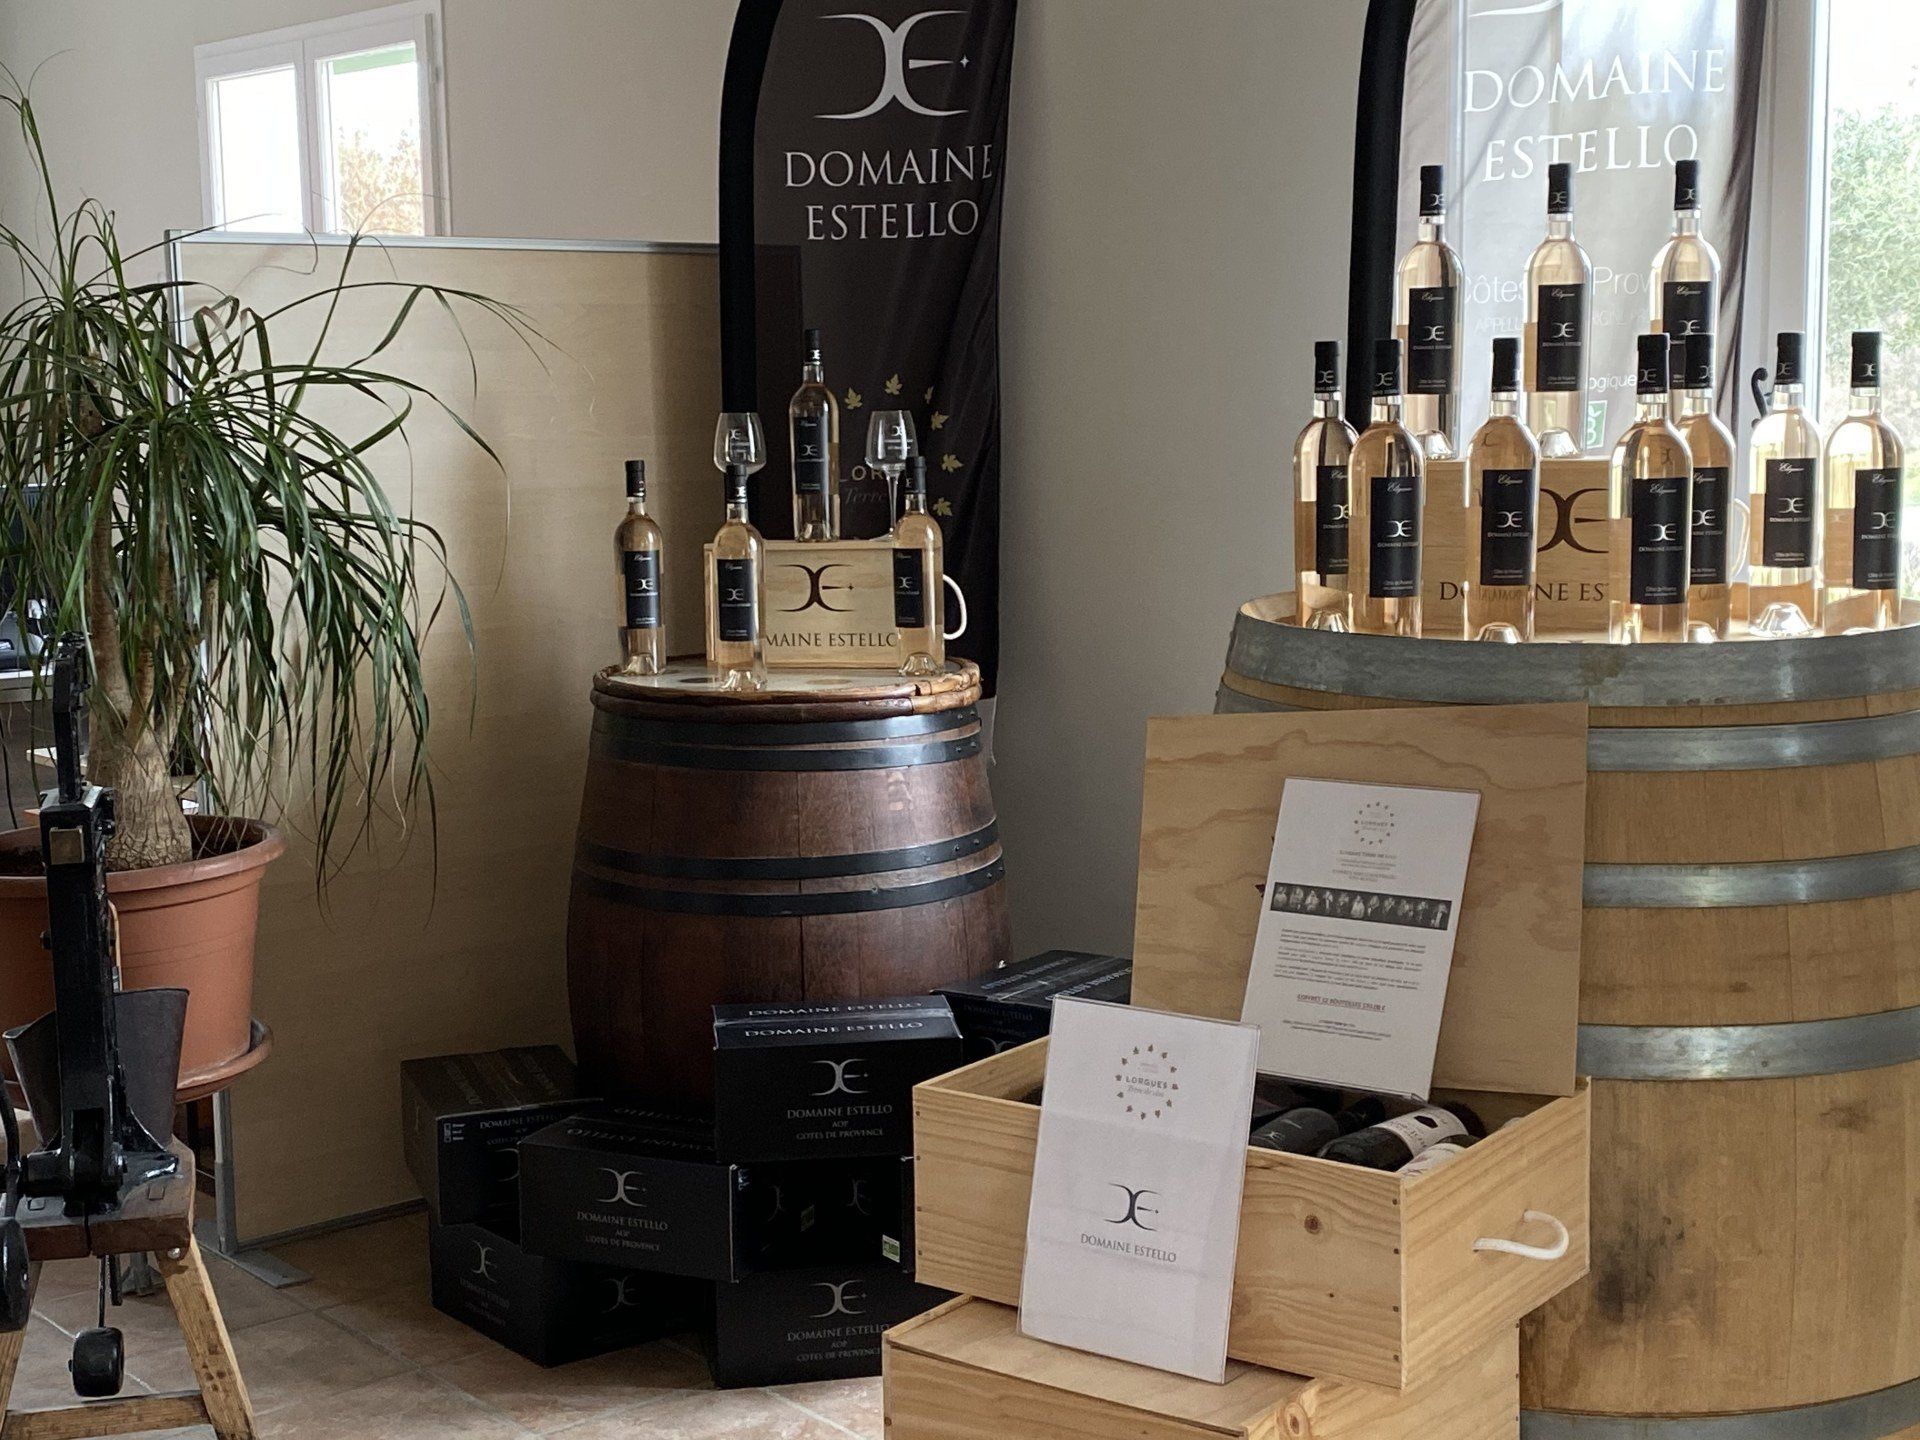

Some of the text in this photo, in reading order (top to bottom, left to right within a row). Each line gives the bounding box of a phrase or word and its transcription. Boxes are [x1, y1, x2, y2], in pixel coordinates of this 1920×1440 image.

[1463, 49, 1727, 113] DOMAINE
[1482, 124, 1699, 182] ESTELLO
[784, 144, 993, 188] DOMAINE
[806, 200, 979, 241] ESTELLO
[1589, 374, 1637, 393] ogique
[765, 632, 822, 648] MAINE
[749, 1006, 840, 1017] DOMAINE
[745, 1022, 924, 1038] DOMAINE ESTELLO
[1125, 1075, 1168, 1090] LORGUES
[787, 1104, 893, 1119] DOMAINE ESTELLO
[577, 1210, 669, 1231] DOMAINE ESTELLO
[1080, 1233, 1178, 1263] DOMAINE ESTELLO
[787, 1327, 843, 1342] DOMAINE
